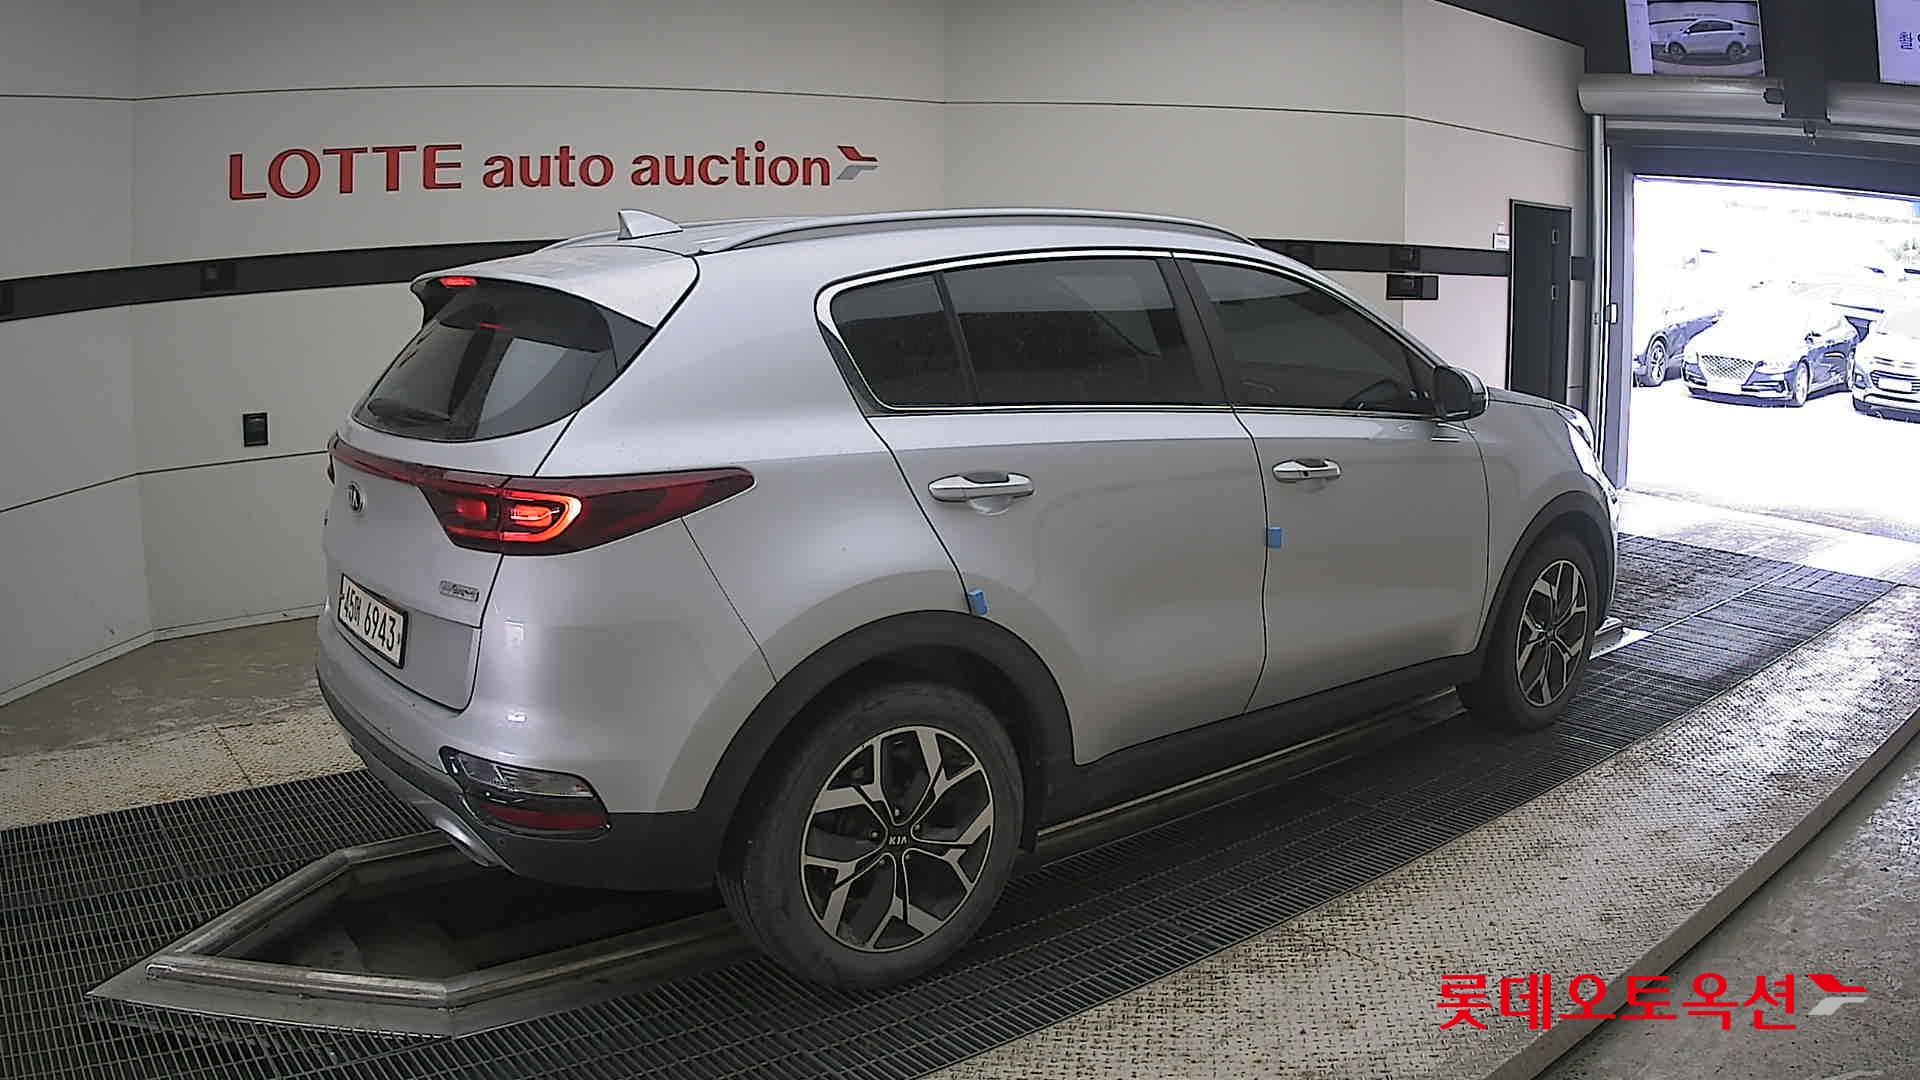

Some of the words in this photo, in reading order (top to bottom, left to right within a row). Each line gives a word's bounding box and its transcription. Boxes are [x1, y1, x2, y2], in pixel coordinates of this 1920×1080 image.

[228, 144, 463, 201] LOTTE
[482, 145, 614, 189] auto
[629, 140, 831, 187] auction
[364, 602, 396, 652] 6943
[888, 835, 908, 846] KIA
